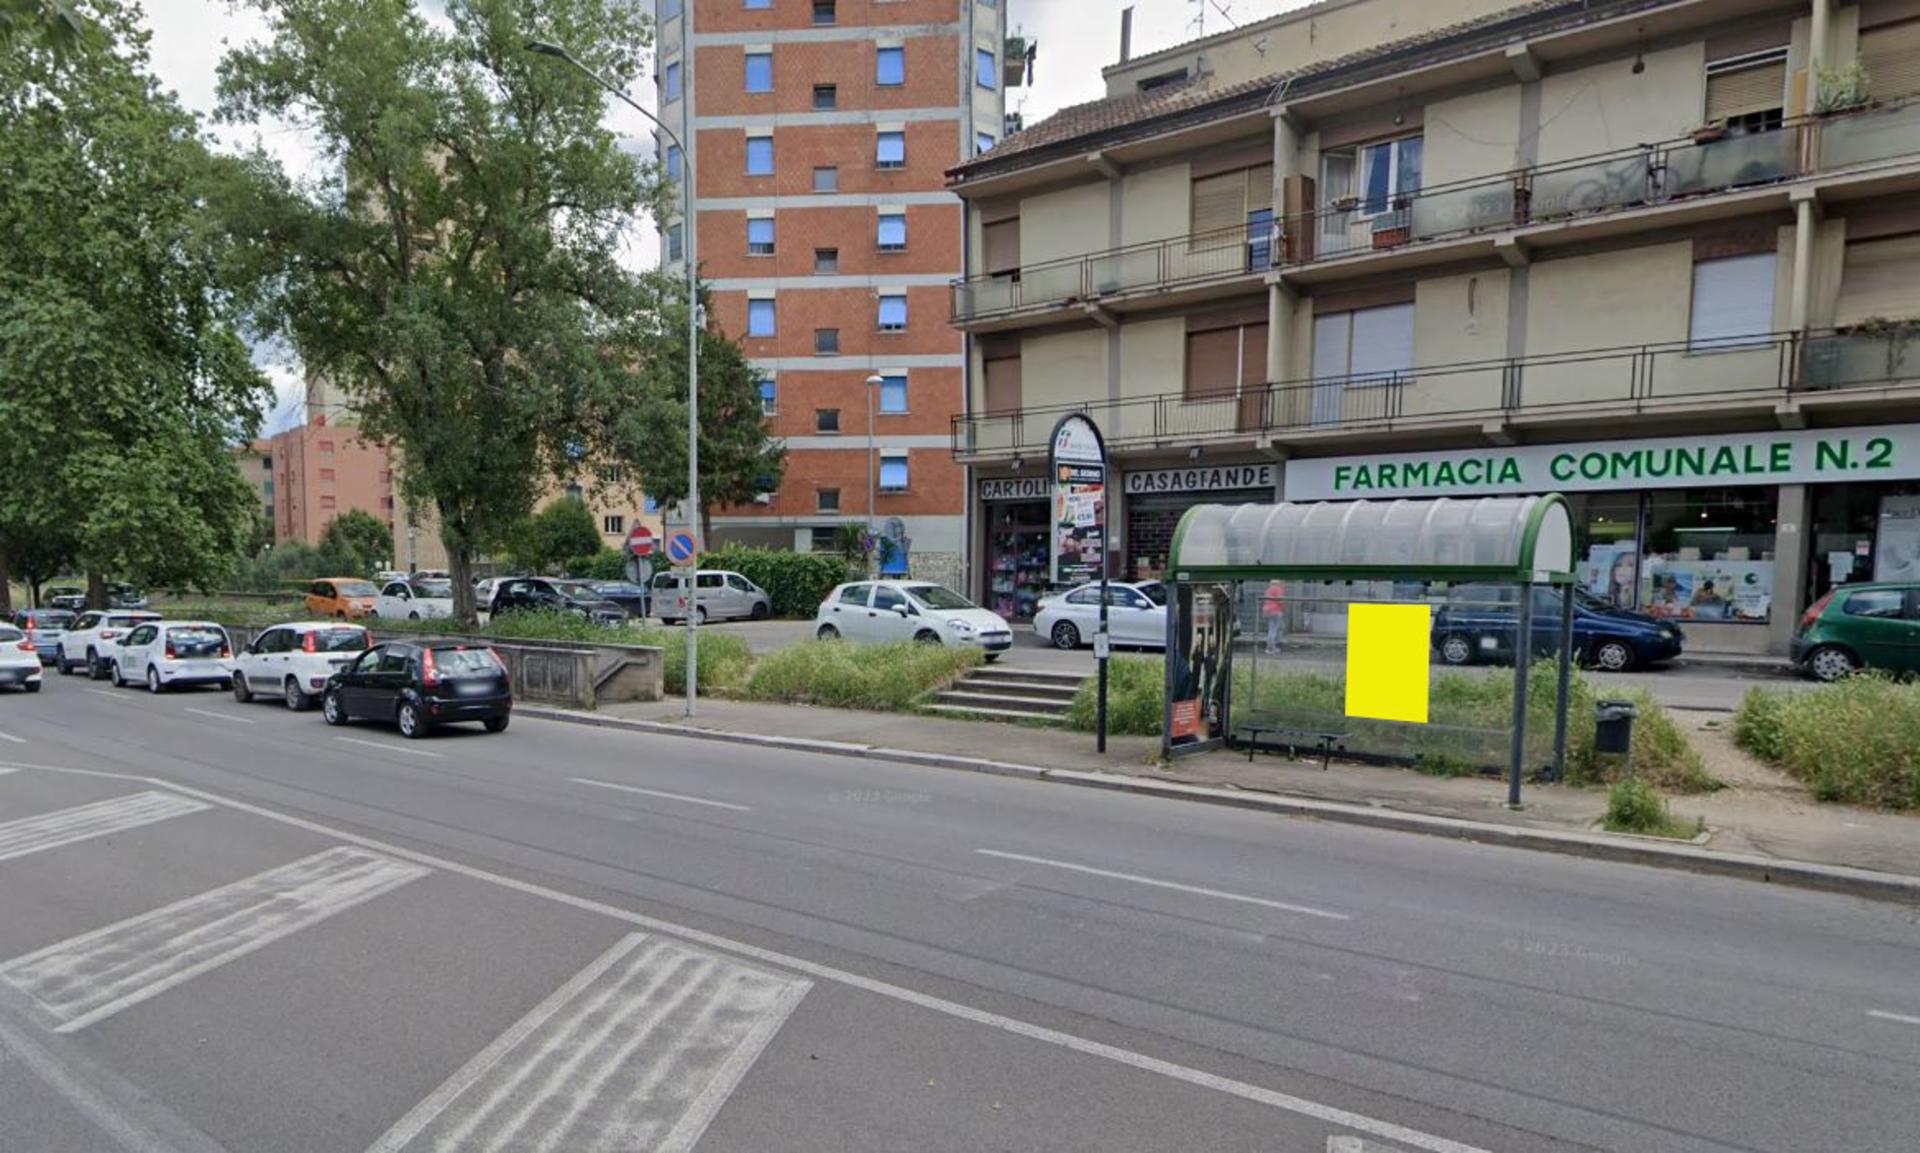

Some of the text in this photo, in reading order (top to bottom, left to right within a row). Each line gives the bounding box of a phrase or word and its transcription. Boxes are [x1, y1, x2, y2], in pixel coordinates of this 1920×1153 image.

[1334, 437, 1893, 490] FARMACIA COMUNALE N.2
[983, 478, 1054, 498] CARTOLI
